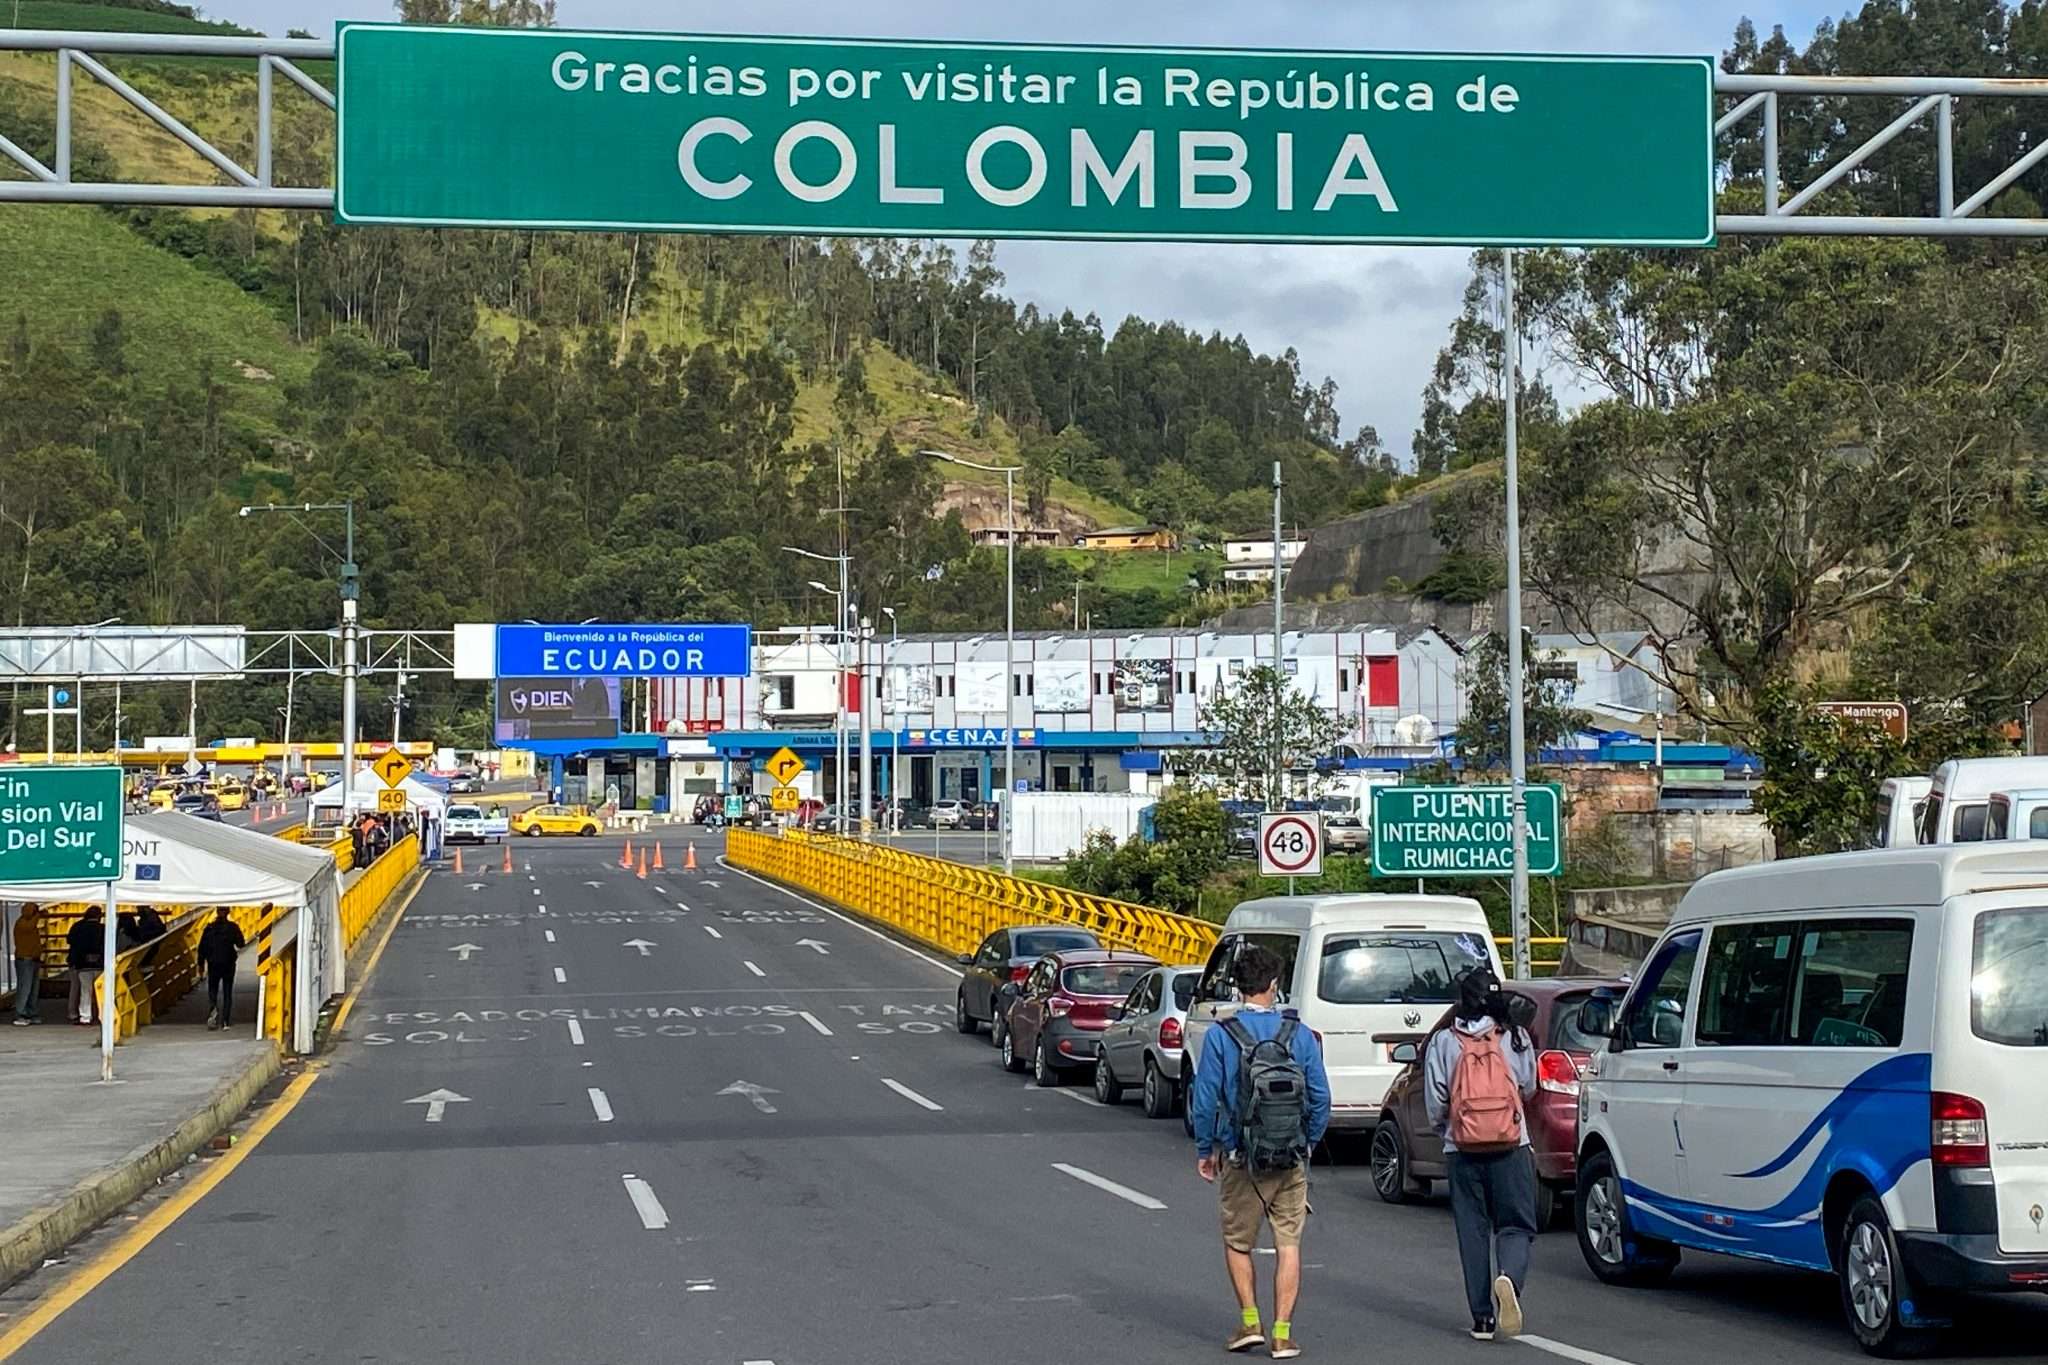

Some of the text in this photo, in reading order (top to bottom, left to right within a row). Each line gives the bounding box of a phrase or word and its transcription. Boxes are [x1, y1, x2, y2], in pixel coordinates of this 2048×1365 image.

[551, 50, 1521, 120] Gracias por visitar la República de
[677, 115, 1400, 212] COLOMBIA
[543, 631, 704, 645] Bienvenido a la República del
[543, 649, 704, 671] ECUADOR
[382, 792, 403, 804] 40
[775, 790, 796, 801] 40
[59, 801, 103, 822] Vial
[7, 826, 96, 850] Del Sur
[1271, 831, 1304, 853] 48
[1403, 847, 1517, 868] RUMICHAC
